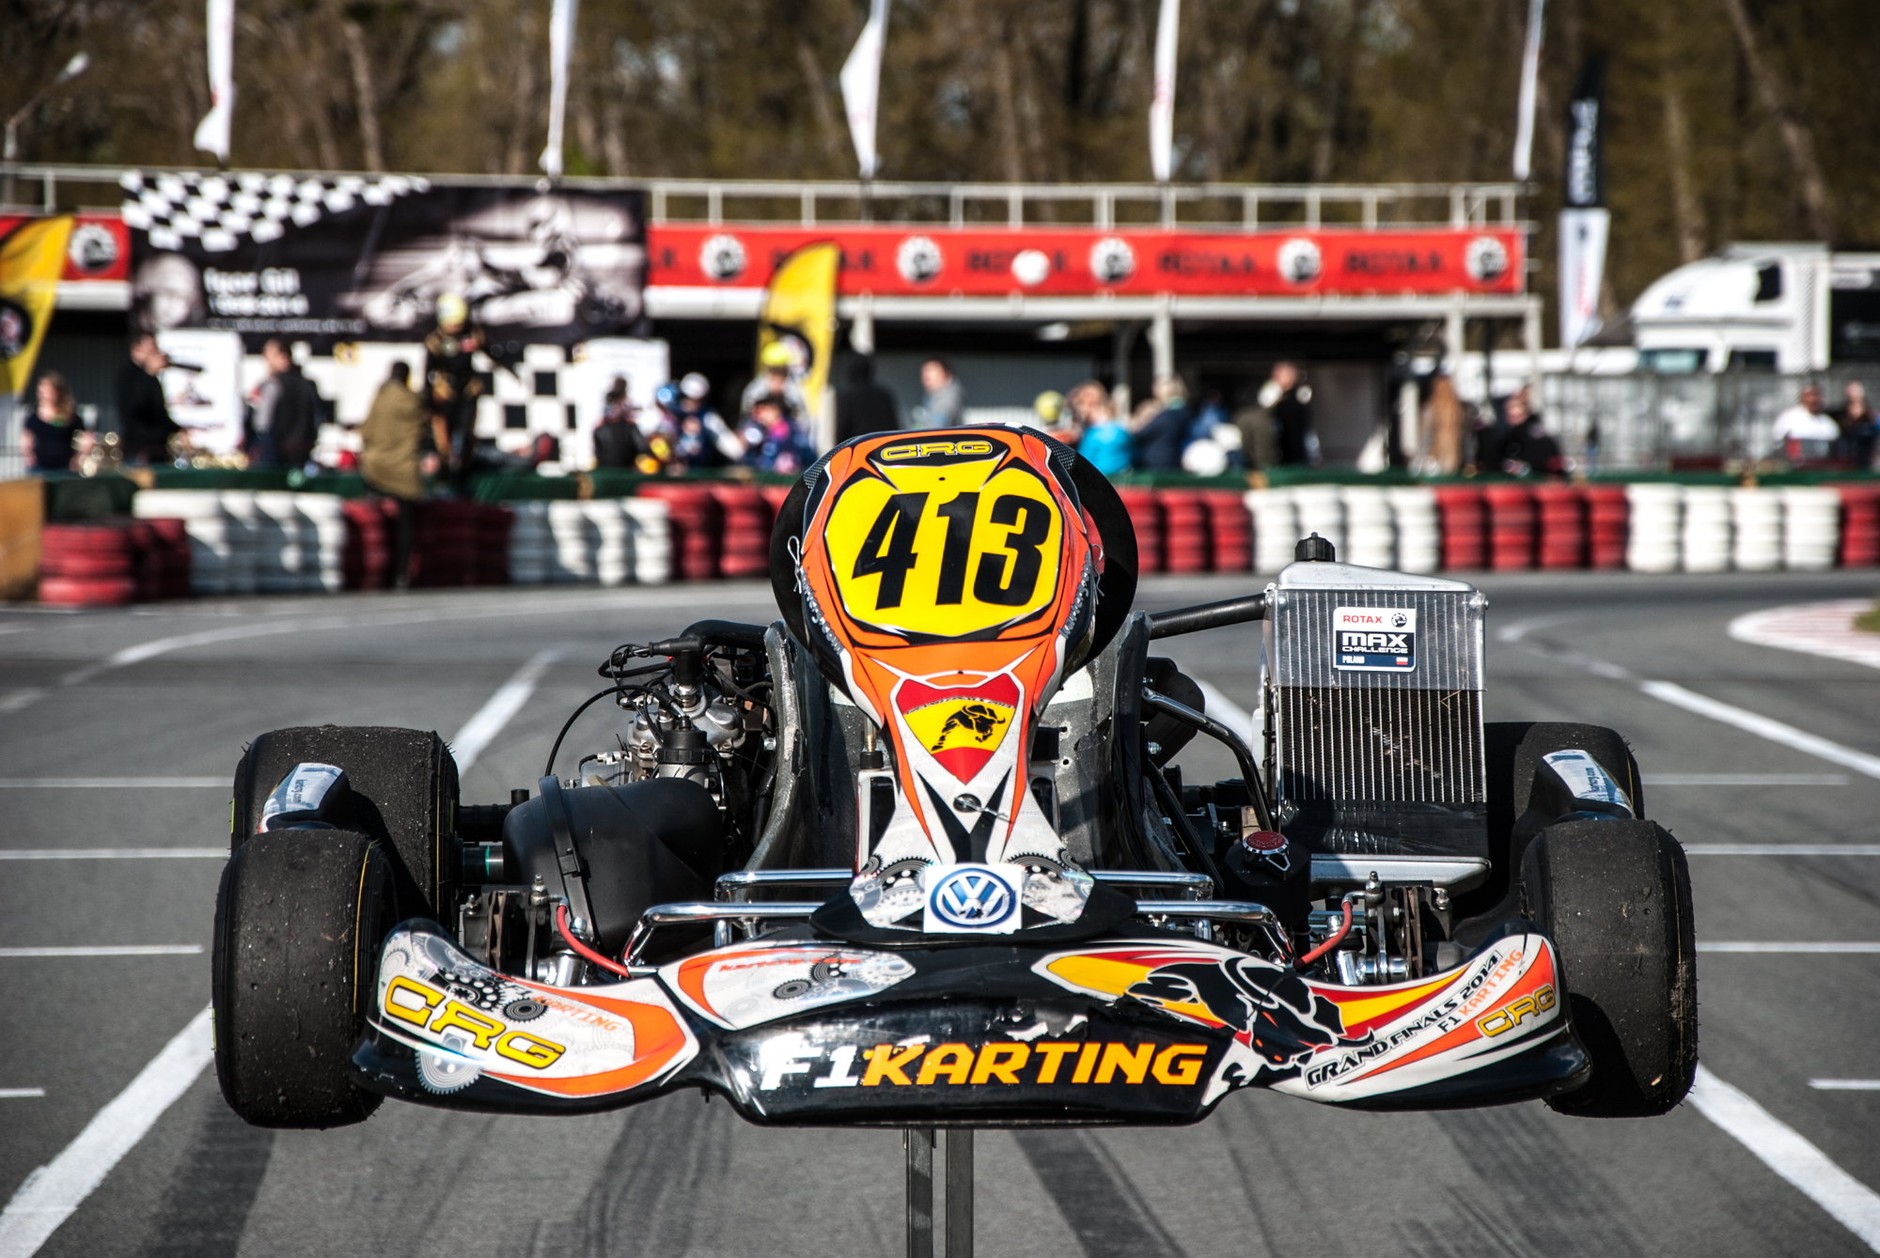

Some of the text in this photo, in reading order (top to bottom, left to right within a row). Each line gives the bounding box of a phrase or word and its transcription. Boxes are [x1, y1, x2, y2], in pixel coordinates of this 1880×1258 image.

[880, 441, 993, 461] CRG
[851, 491, 1052, 611] 413
[1342, 632, 1408, 648] MAX
[1343, 615, 1383, 624] ROTAX
[1341, 646, 1409, 654] CHALLENGE
[1438, 948, 1524, 1034] F1 KARTING
[1477, 984, 1556, 1037] CRG
[384, 975, 566, 1069] CRG
[1306, 953, 1500, 1088] GRAND FINALS 2014
